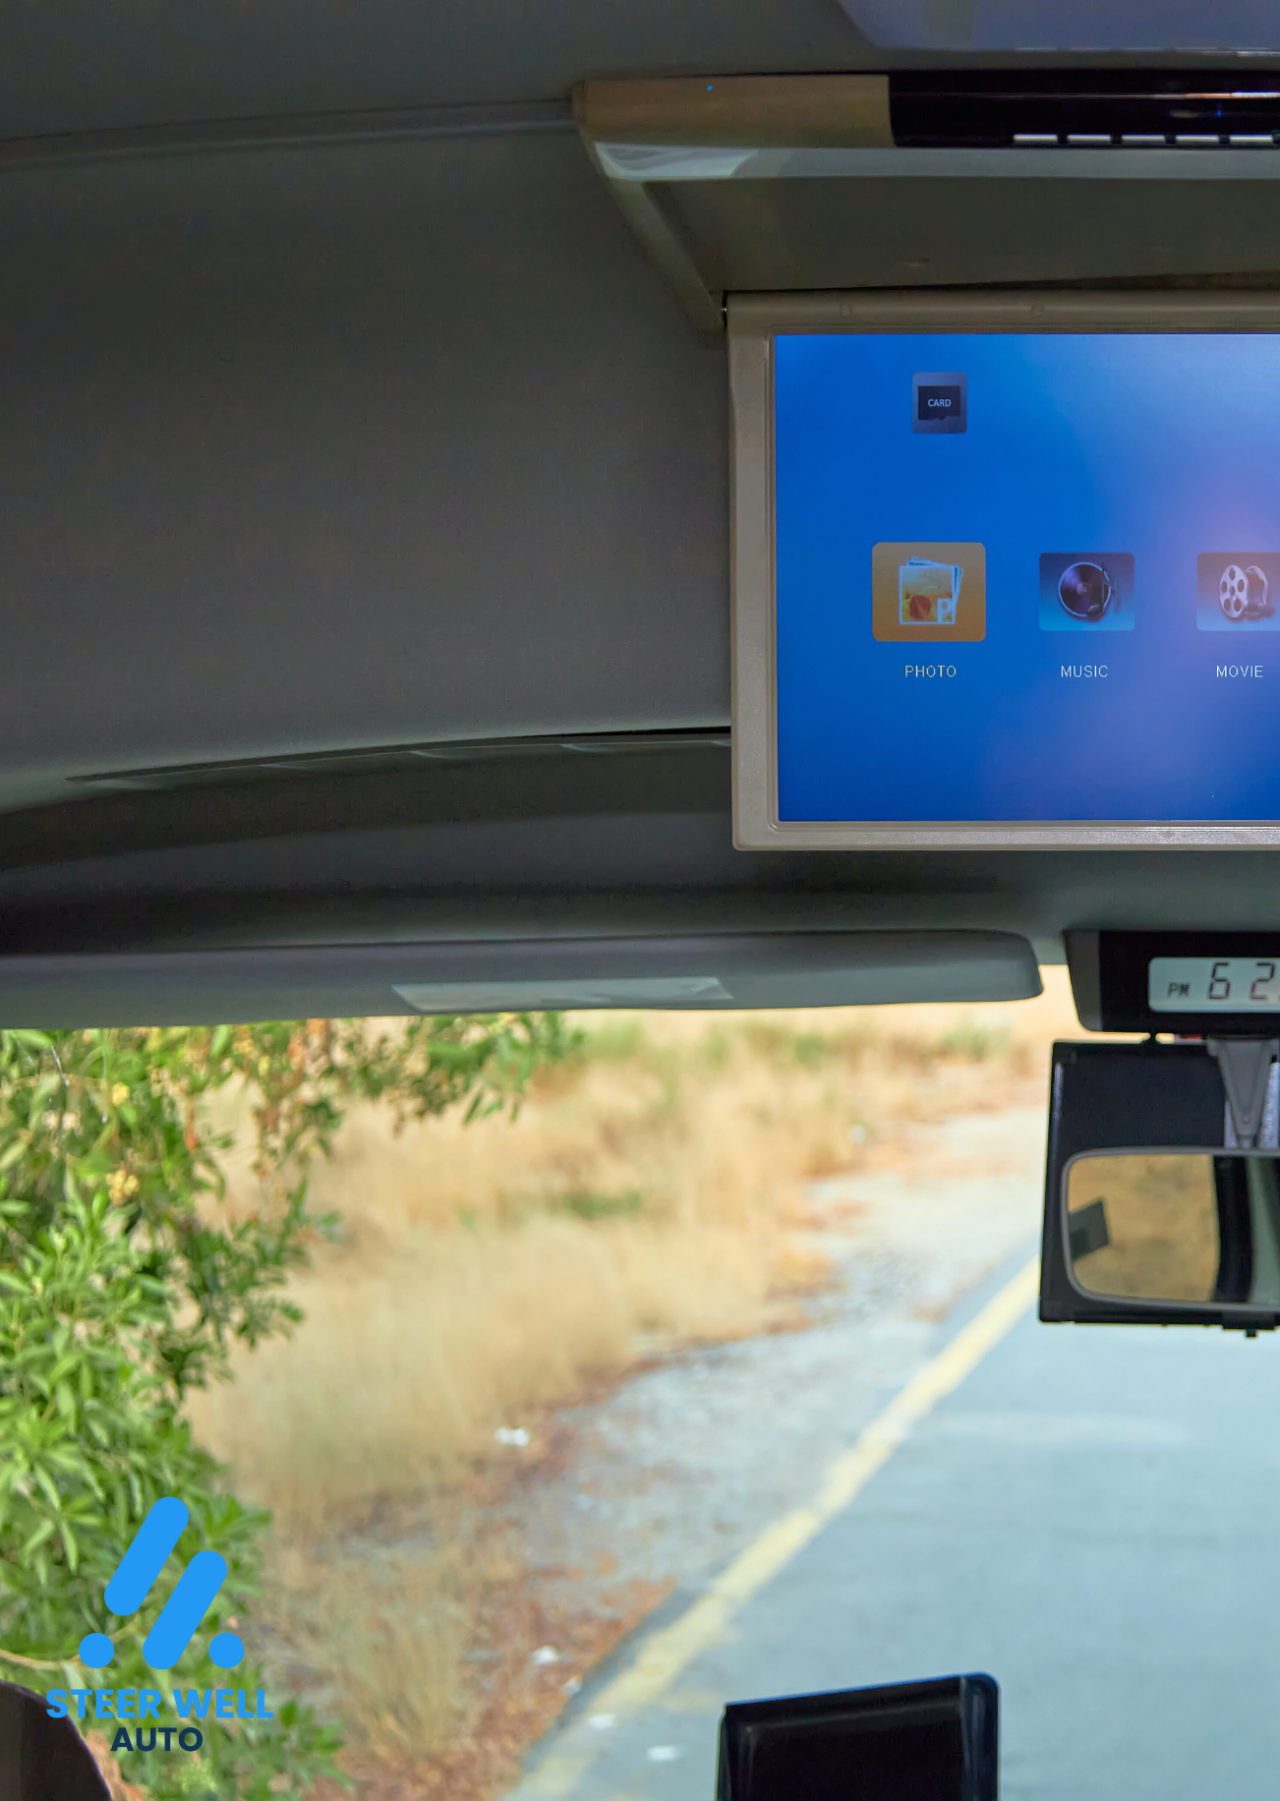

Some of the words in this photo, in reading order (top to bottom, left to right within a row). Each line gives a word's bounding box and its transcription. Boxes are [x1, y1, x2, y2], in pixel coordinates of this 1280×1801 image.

[928, 398, 952, 407] CARD
[905, 665, 957, 678] PHOTO
[1061, 665, 1108, 678] MUSIC
[1216, 665, 1263, 678] MOVIE
[1167, 982, 1190, 997] PM
